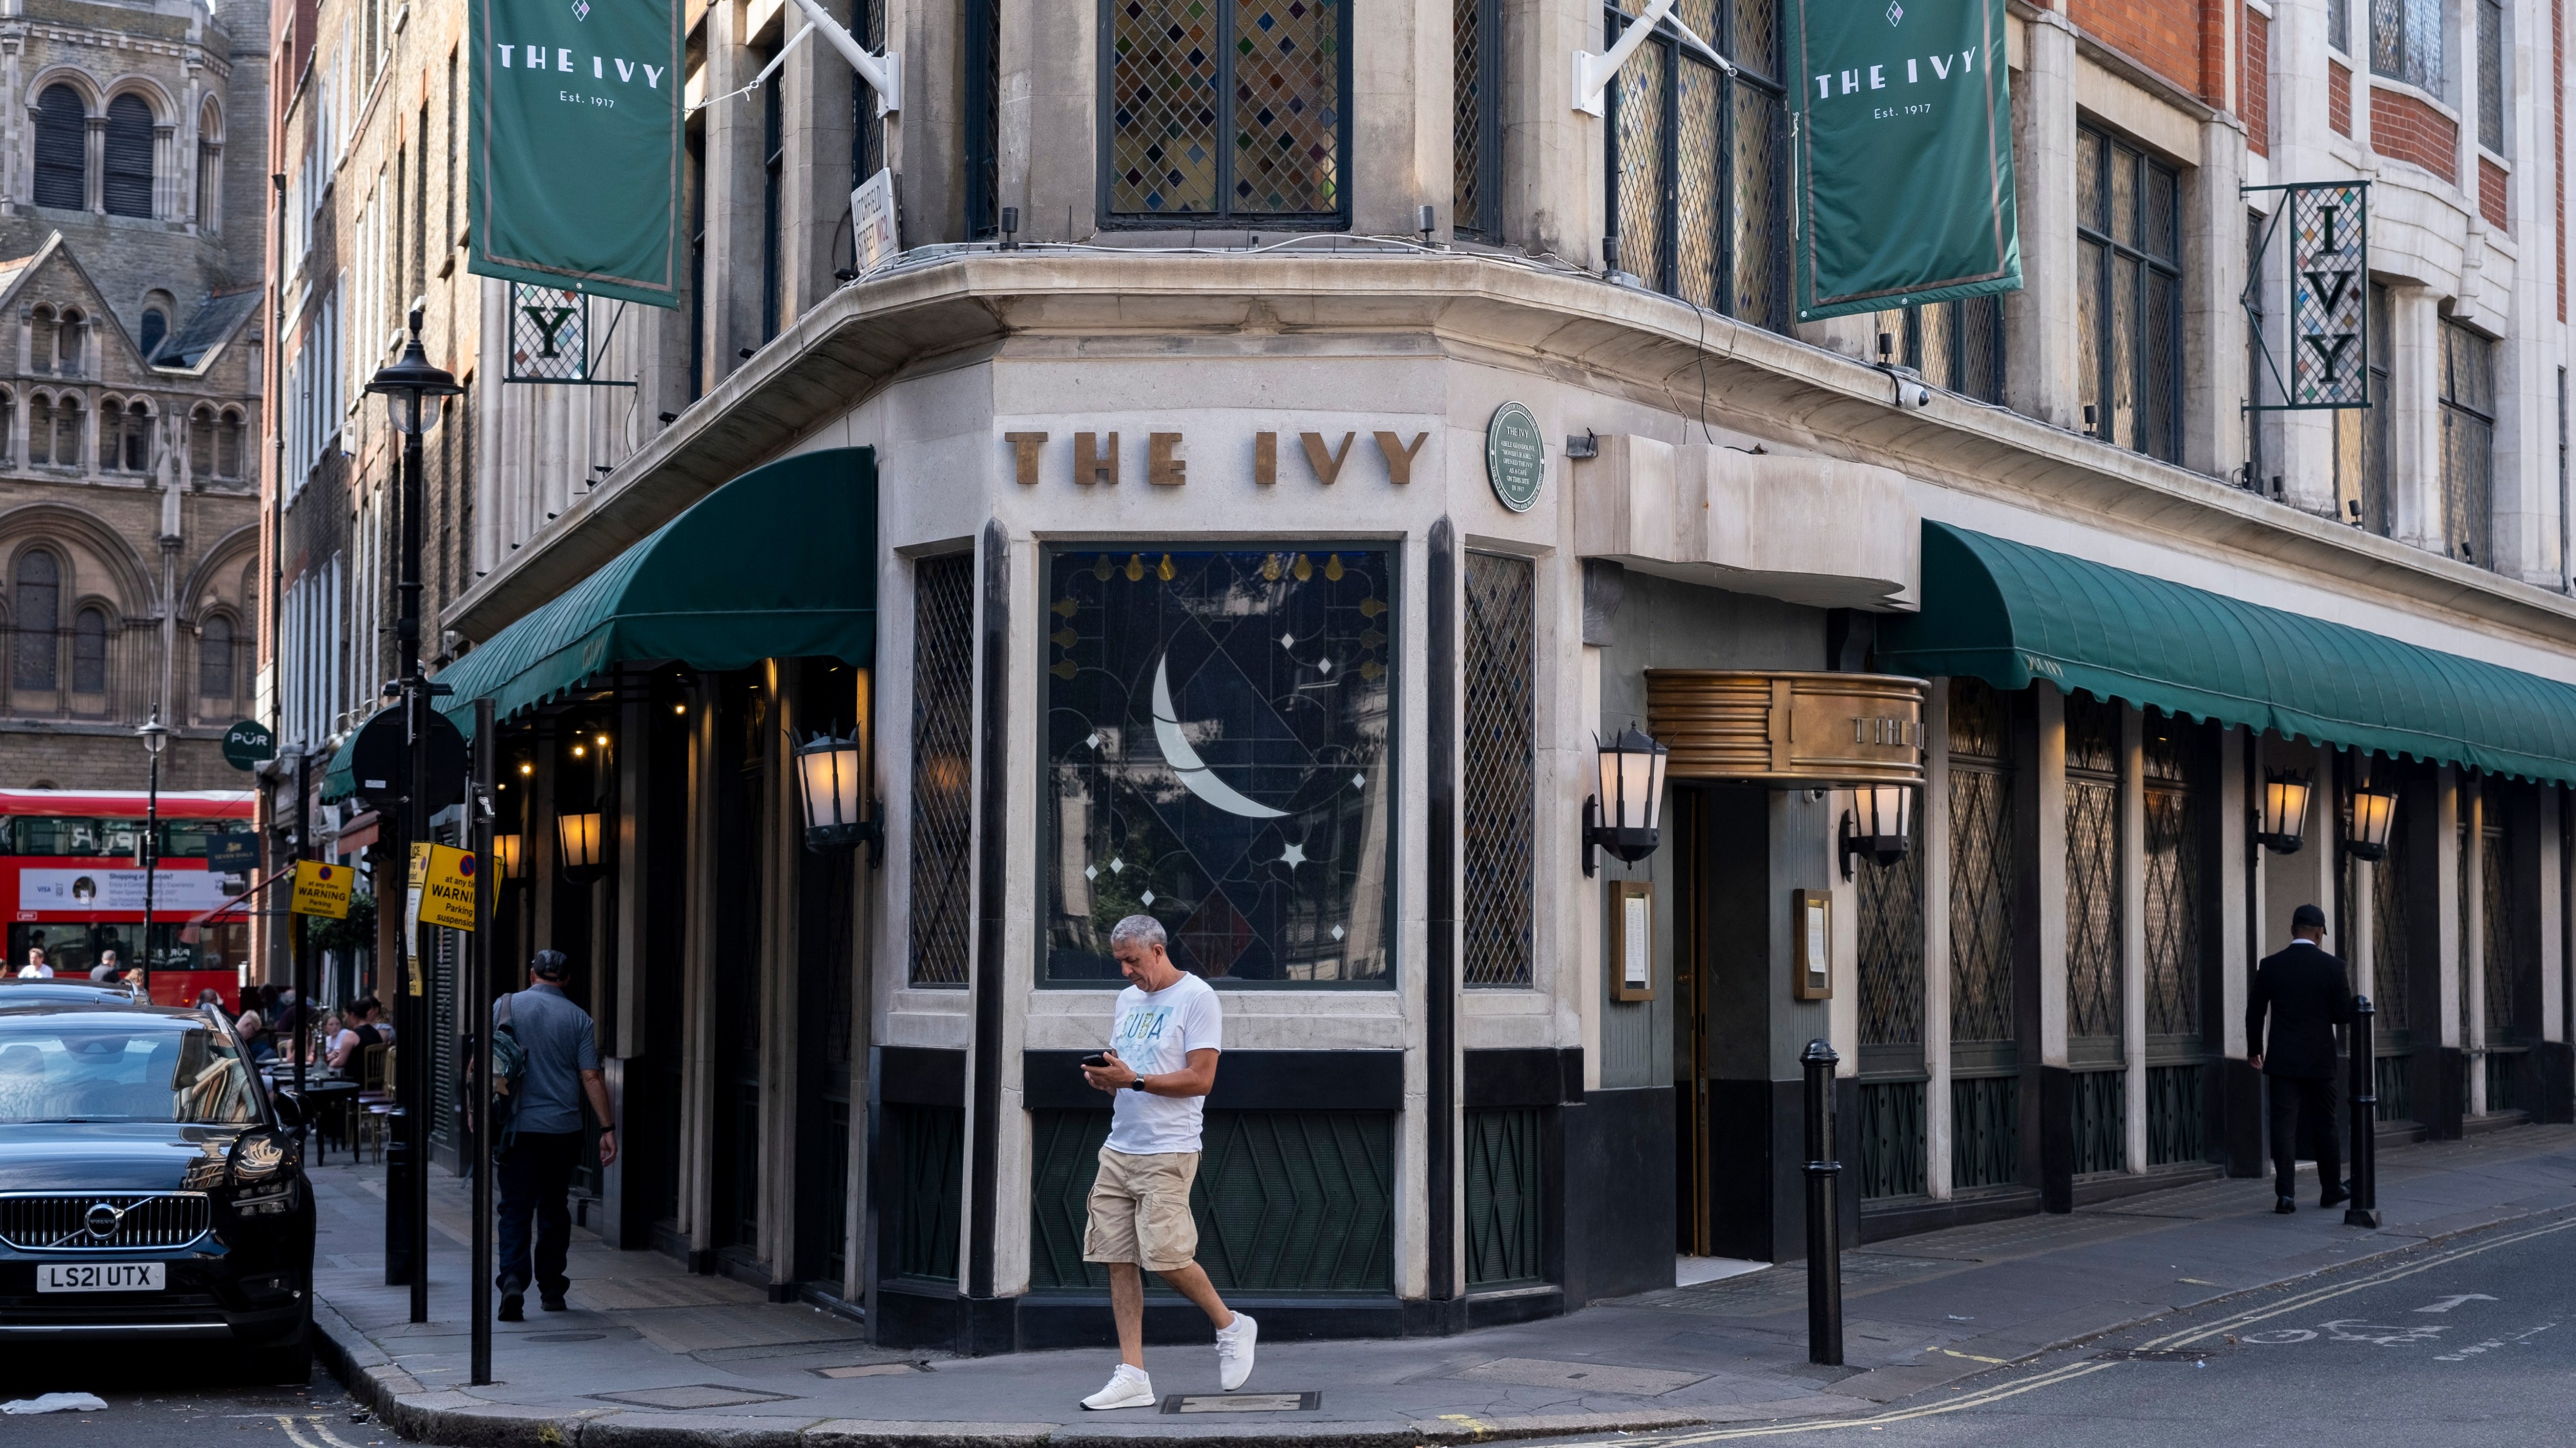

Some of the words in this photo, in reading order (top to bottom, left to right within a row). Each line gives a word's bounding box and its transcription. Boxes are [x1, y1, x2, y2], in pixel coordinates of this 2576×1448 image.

[498, 43, 574, 73] THE
[593, 56, 665, 89] IVY
[1815, 64, 1886, 99] THE
[1907, 46, 1976, 83] IVY
[560, 90, 585, 104] Est.
[590, 96, 615, 109] 1917
[1874, 108, 1899, 120] Est.
[1904, 103, 1931, 115] 1917
[854, 185, 882, 227] LITCHFIELD
[857, 223, 875, 258] STREET
[875, 214, 889, 245] WC2
[2302, 205, 2355, 383] IVY
[1495, 404, 1515, 427] WESTMINSTER
[1516, 404, 1525, 413] CITY
[1526, 411, 1538, 433] COUNCIL
[1506, 427, 1518, 436] THE
[1518, 428, 1529, 438] IVY
[1005, 432, 1186, 485] THE
[1256, 431, 1430, 485] IVY
[1503, 457, 1518, 466] OPENED
[231, 731, 268, 746] PÜR
[432, 883, 475, 904] WARNI
[454, 878, 466, 888] any
[299, 887, 346, 901] WARNING
[310, 898, 332, 908] Parking
[445, 902, 473, 917] Parking
[1121, 1013, 1164, 1040] CUBA
[51, 1267, 100, 1287] LS21
[108, 1266, 150, 1286] UTX
